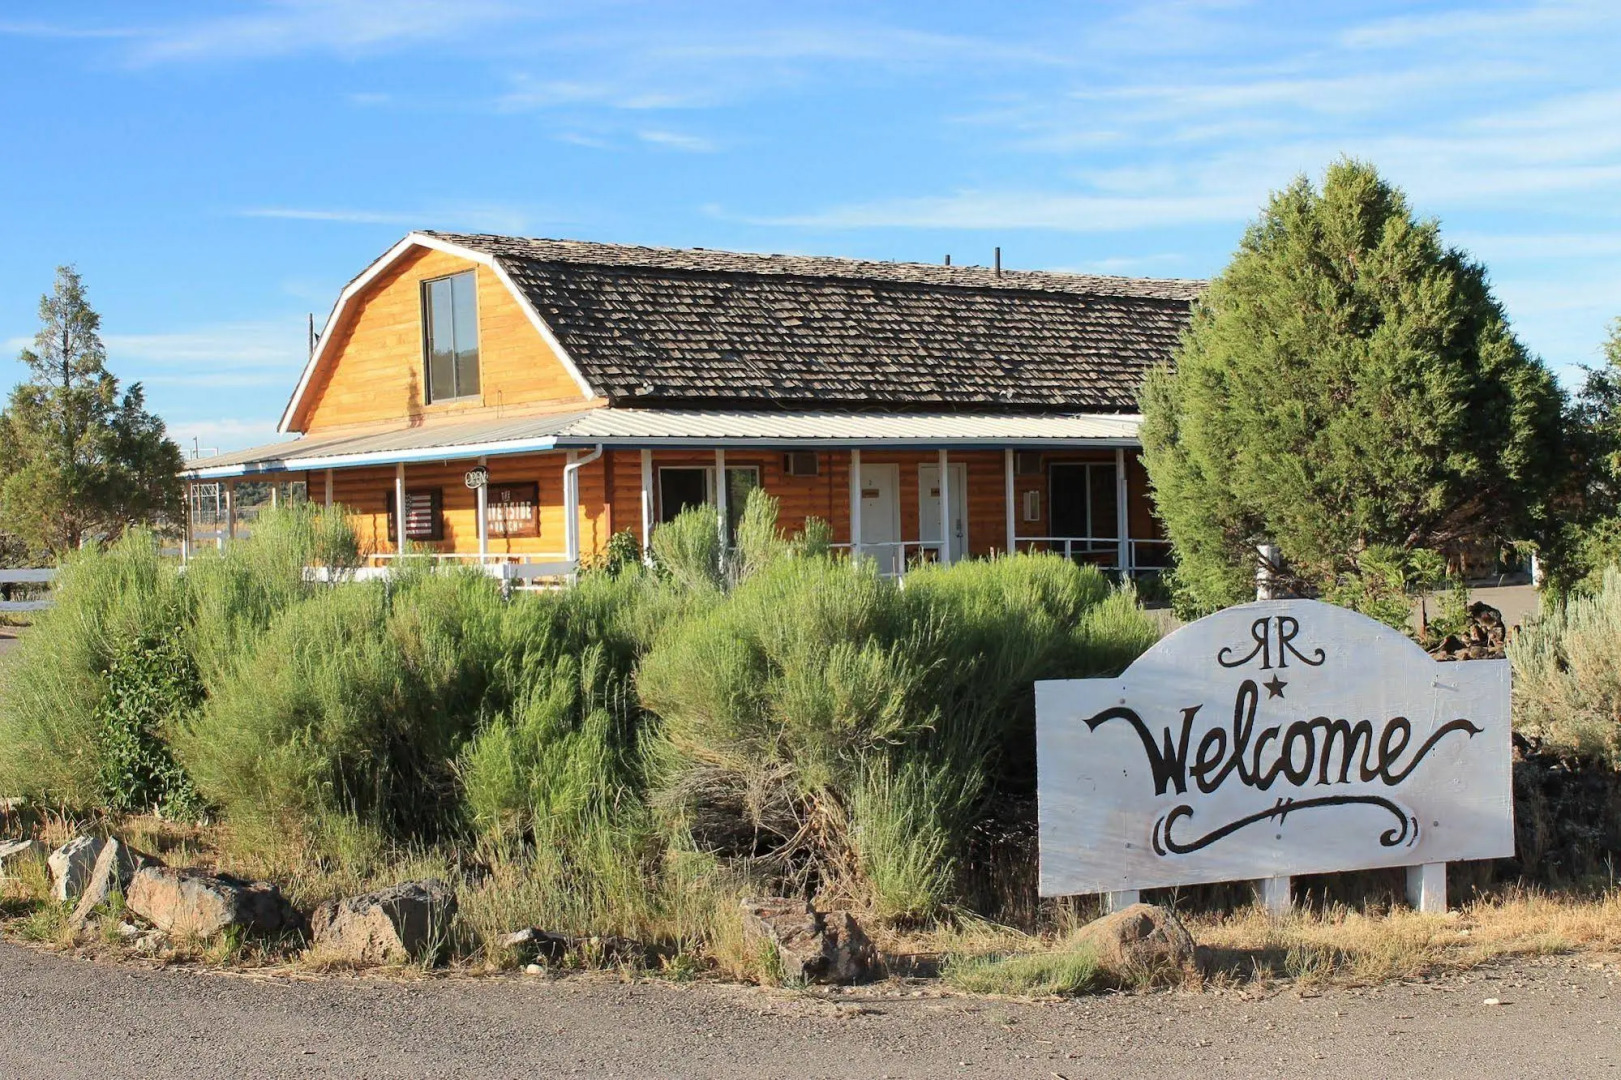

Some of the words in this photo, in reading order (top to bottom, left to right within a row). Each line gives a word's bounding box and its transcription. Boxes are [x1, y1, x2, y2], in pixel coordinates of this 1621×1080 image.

[488, 501, 532, 521] IVERSIDE
[495, 521, 518, 533] RACH
[1082, 679, 1485, 796] Welcome
